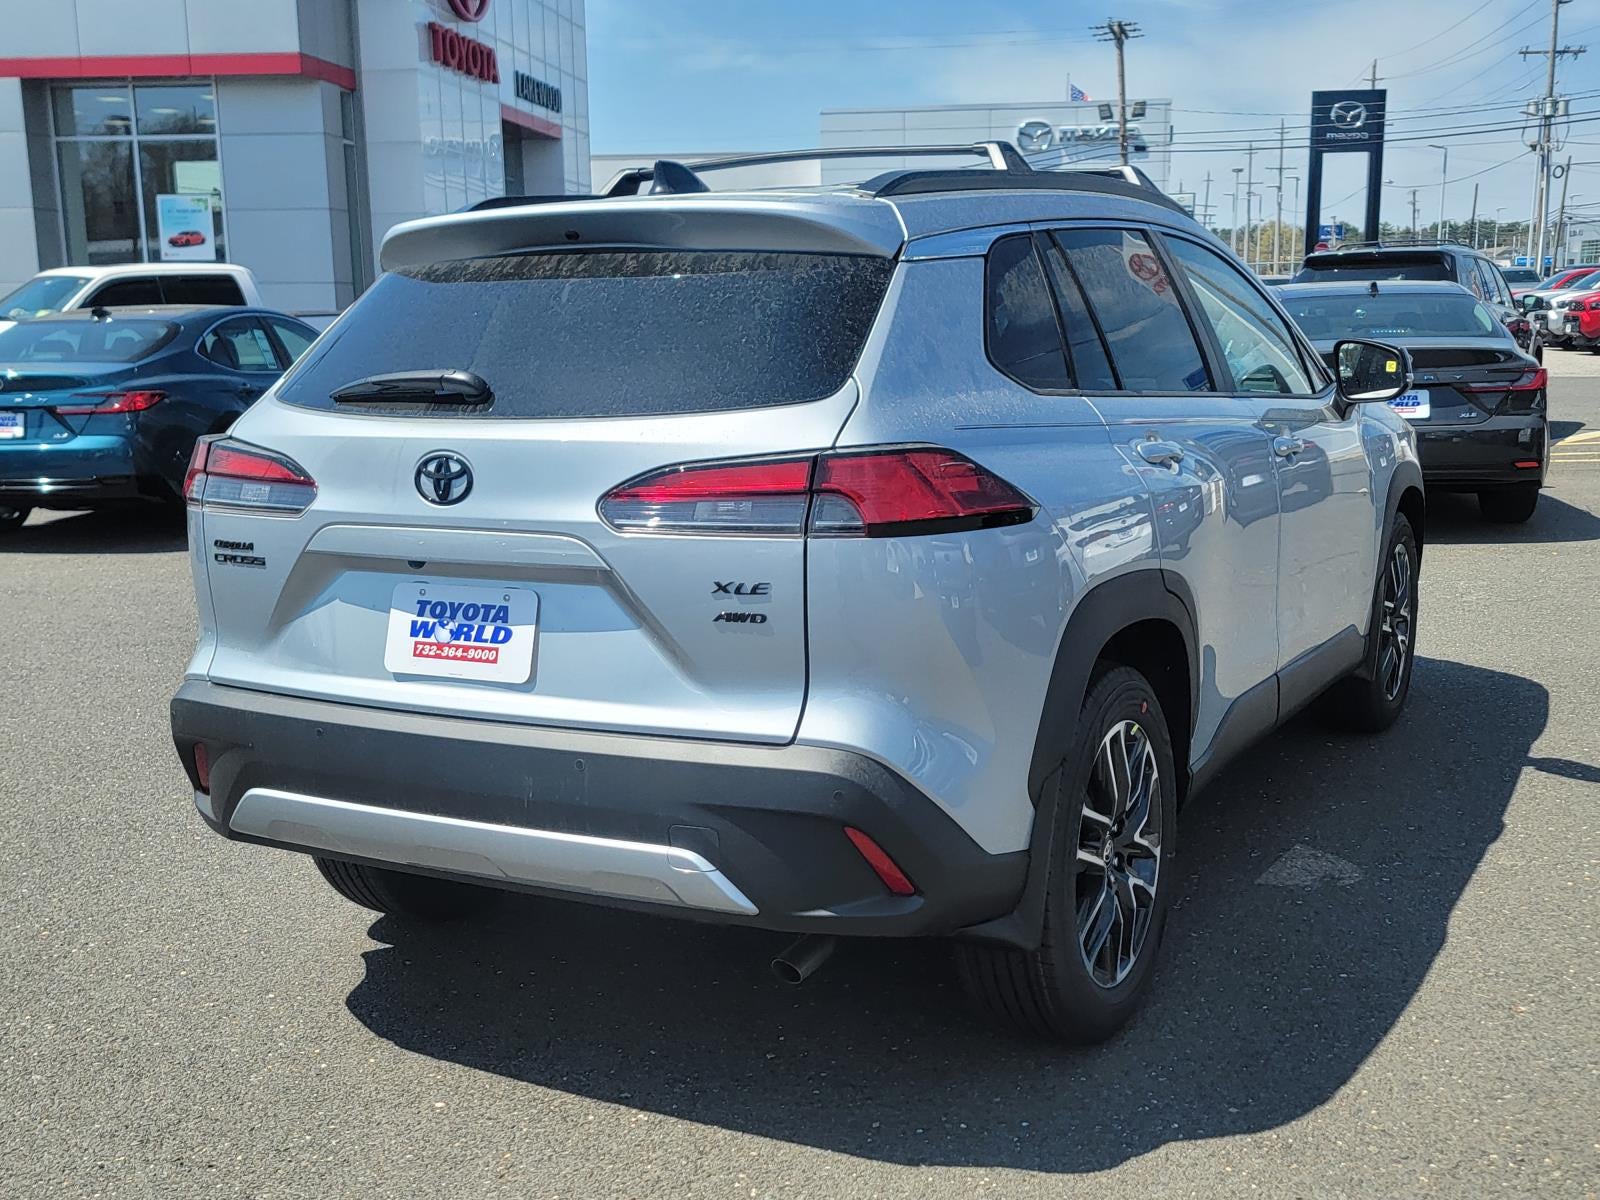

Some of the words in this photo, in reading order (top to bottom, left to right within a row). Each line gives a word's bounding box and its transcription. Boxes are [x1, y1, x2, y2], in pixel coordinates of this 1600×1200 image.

[428, 22, 500, 84] TOYOTA
[1326, 132, 1369, 140] mazda
[214, 553, 266, 566] CROSS
[710, 581, 771, 595] XLE
[416, 600, 510, 624] TOYOTA
[712, 611, 767, 623] AWD
[410, 619, 513, 644] WORLD
[415, 645, 497, 660] 732-364-9000
